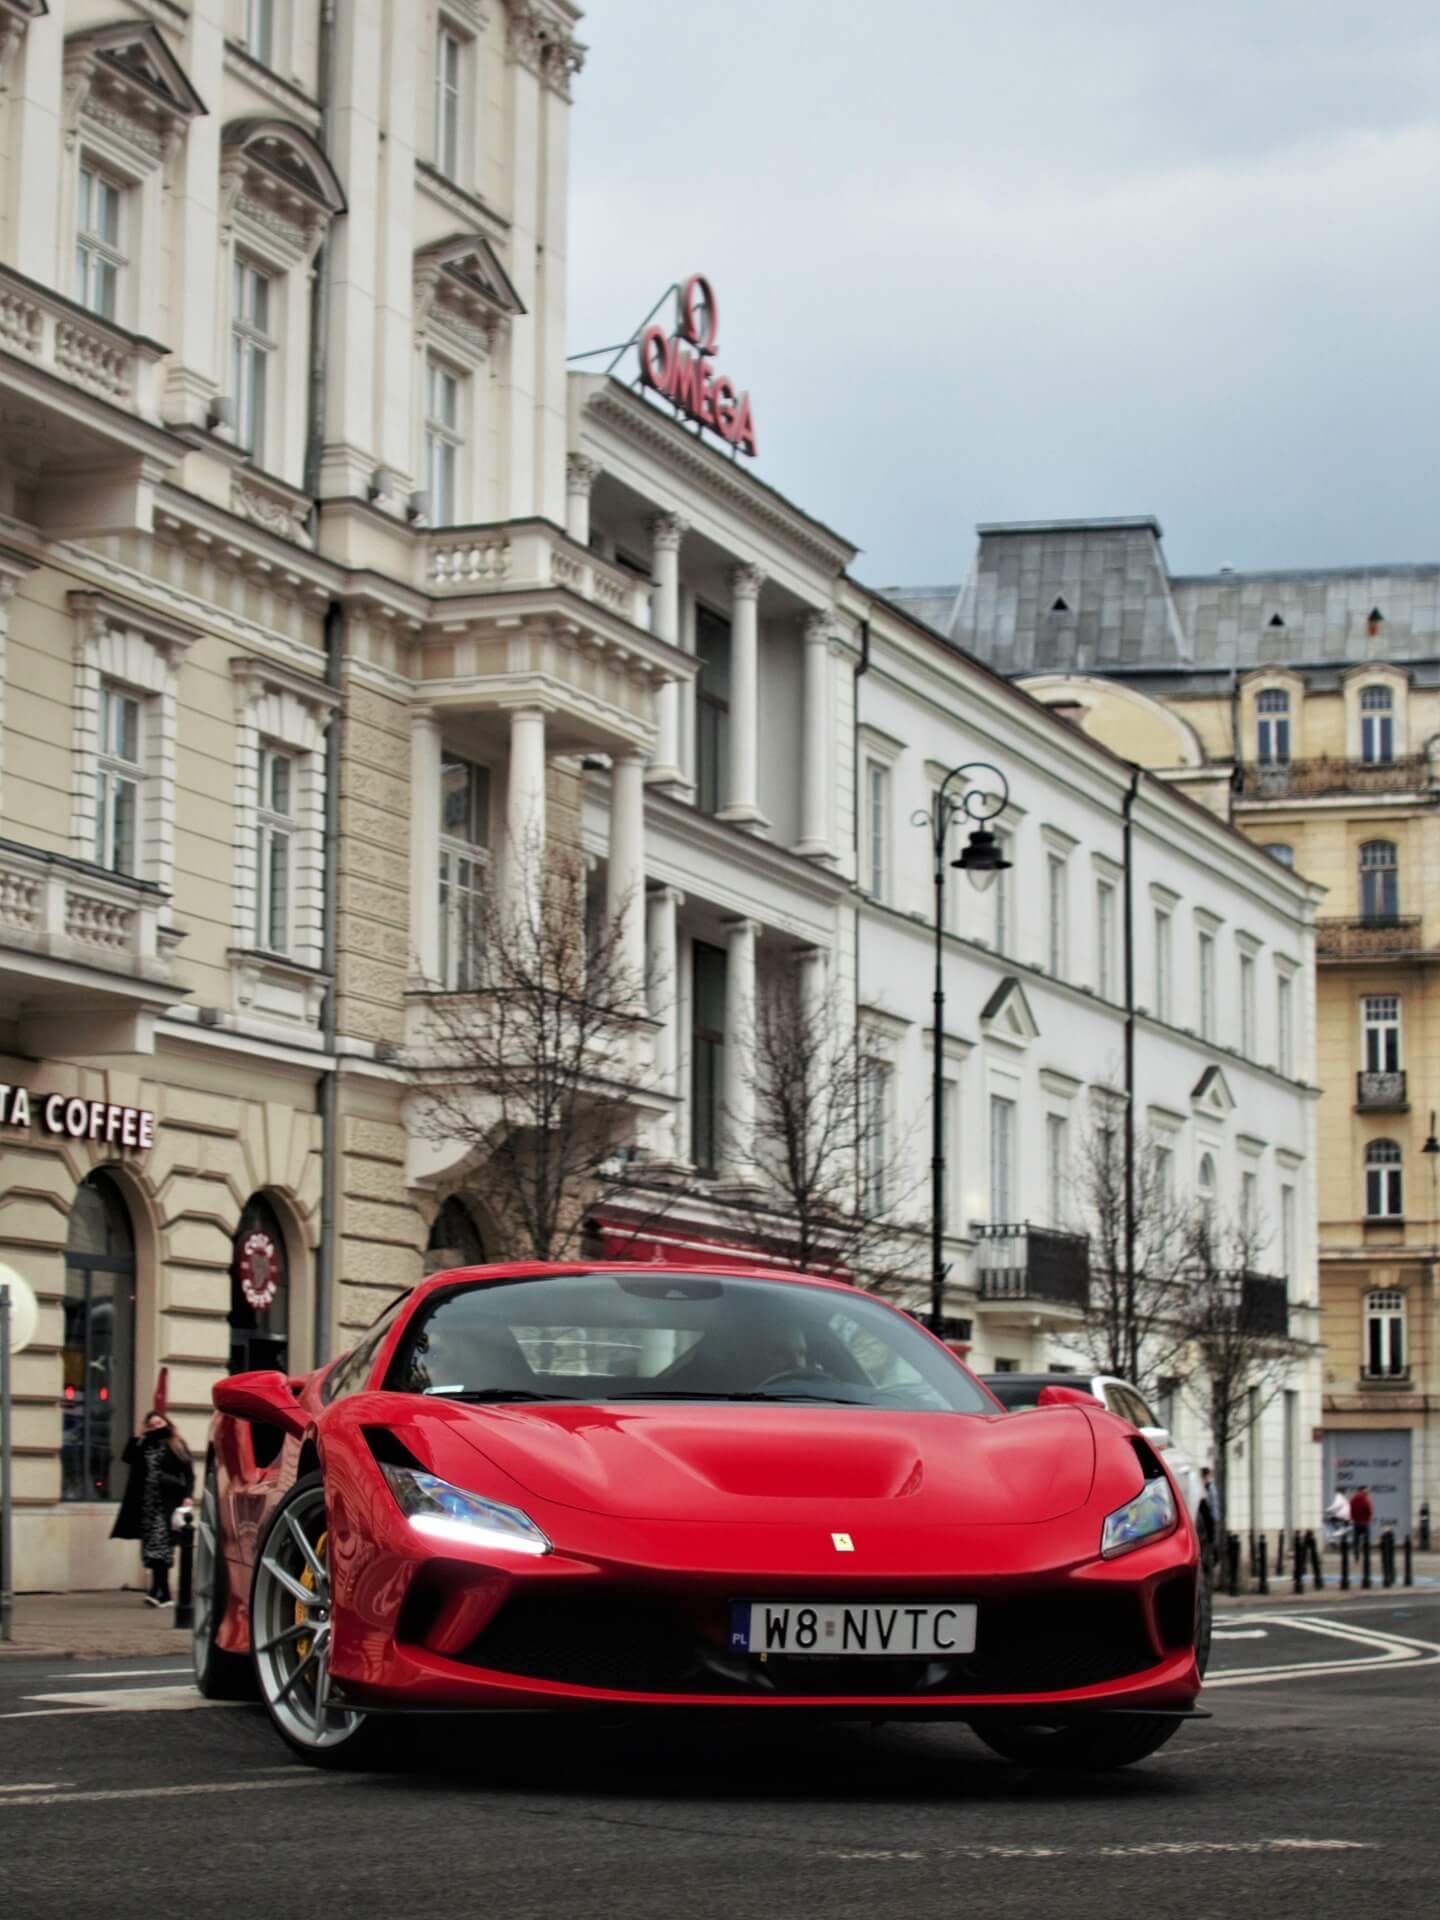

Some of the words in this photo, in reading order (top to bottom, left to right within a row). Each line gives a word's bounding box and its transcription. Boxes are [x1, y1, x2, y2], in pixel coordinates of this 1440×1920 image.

[641, 325, 757, 457] OMEGA
[45, 1093, 154, 1149] COFFEE
[732, 1632, 747, 1646] PL
[765, 1607, 818, 1650] W8
[842, 1608, 958, 1651] NVTC
